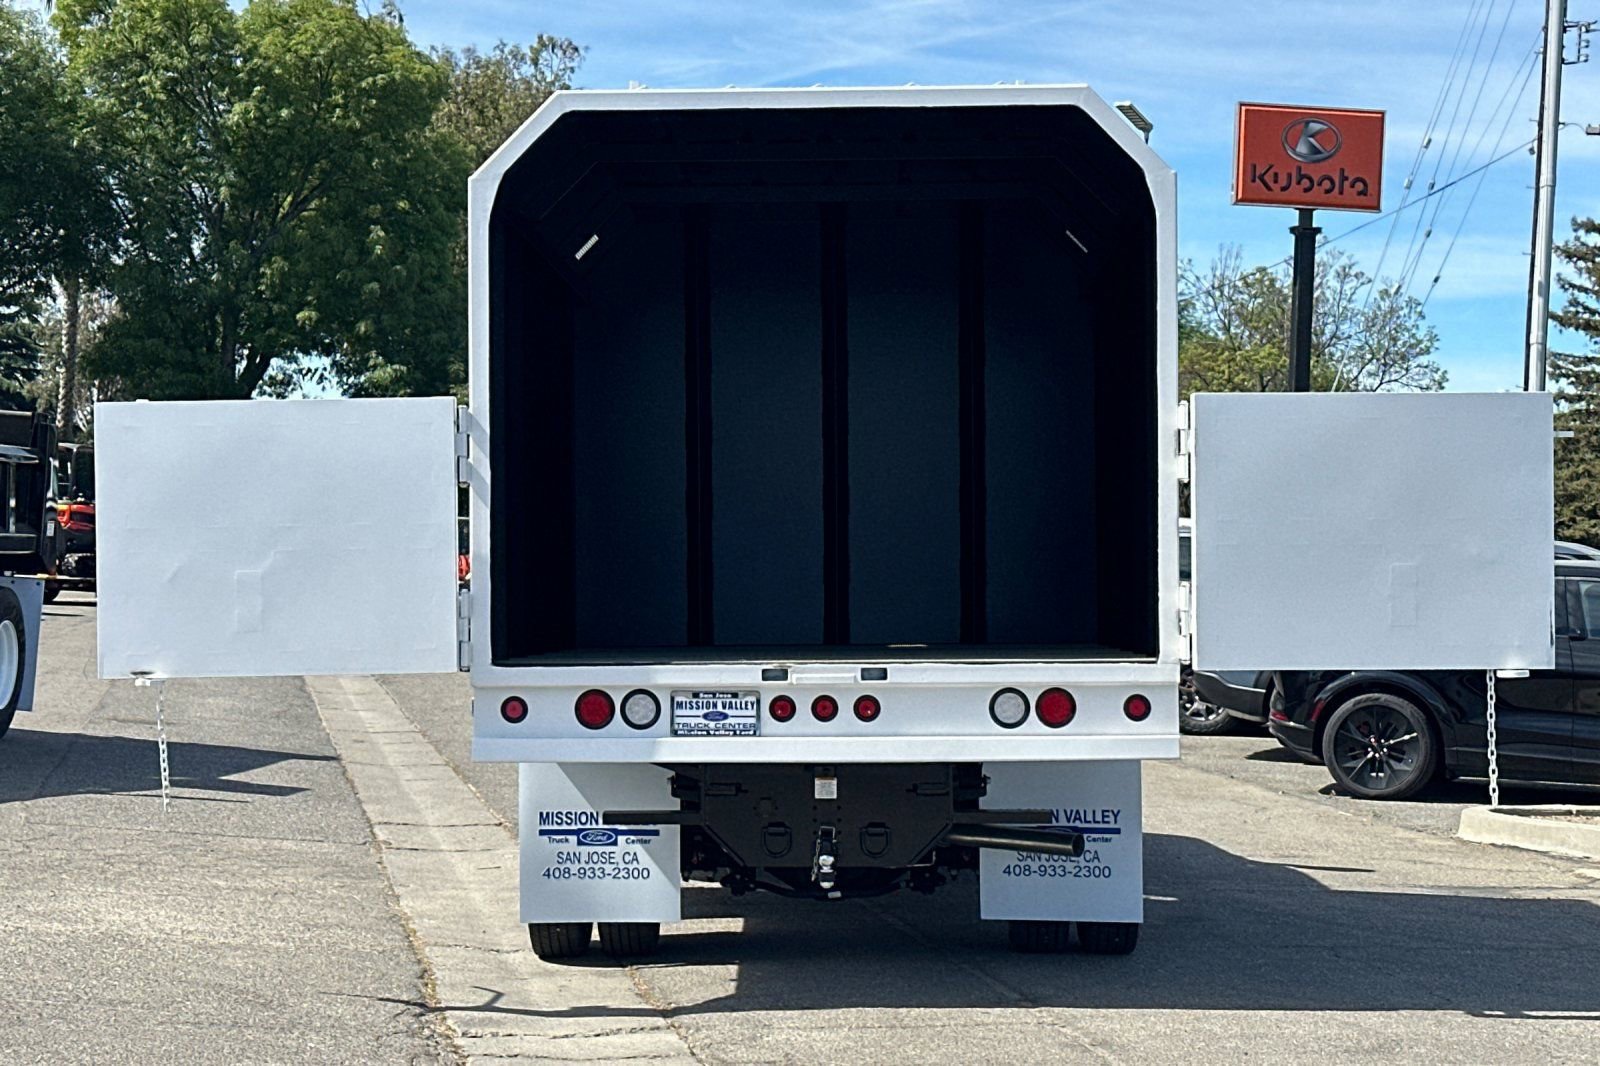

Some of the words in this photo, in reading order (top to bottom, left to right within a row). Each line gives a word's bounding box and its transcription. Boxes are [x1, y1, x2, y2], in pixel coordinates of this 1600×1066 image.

[1250, 163, 1369, 197] Kubota
[675, 700, 718, 710] MISSION
[721, 700, 756, 710] VALLEY
[539, 811, 599, 826] MISSION
[1063, 809, 1121, 824] VALLEY
[556, 851, 581, 864] SAN
[584, 851, 619, 866] JOSE,
[622, 852, 640, 864] CA
[1016, 850, 1041, 862] SAN
[1083, 850, 1101, 862] CA
[542, 867, 650, 879] 408-933-2300
[1002, 864, 1111, 878] 408-933-2300
